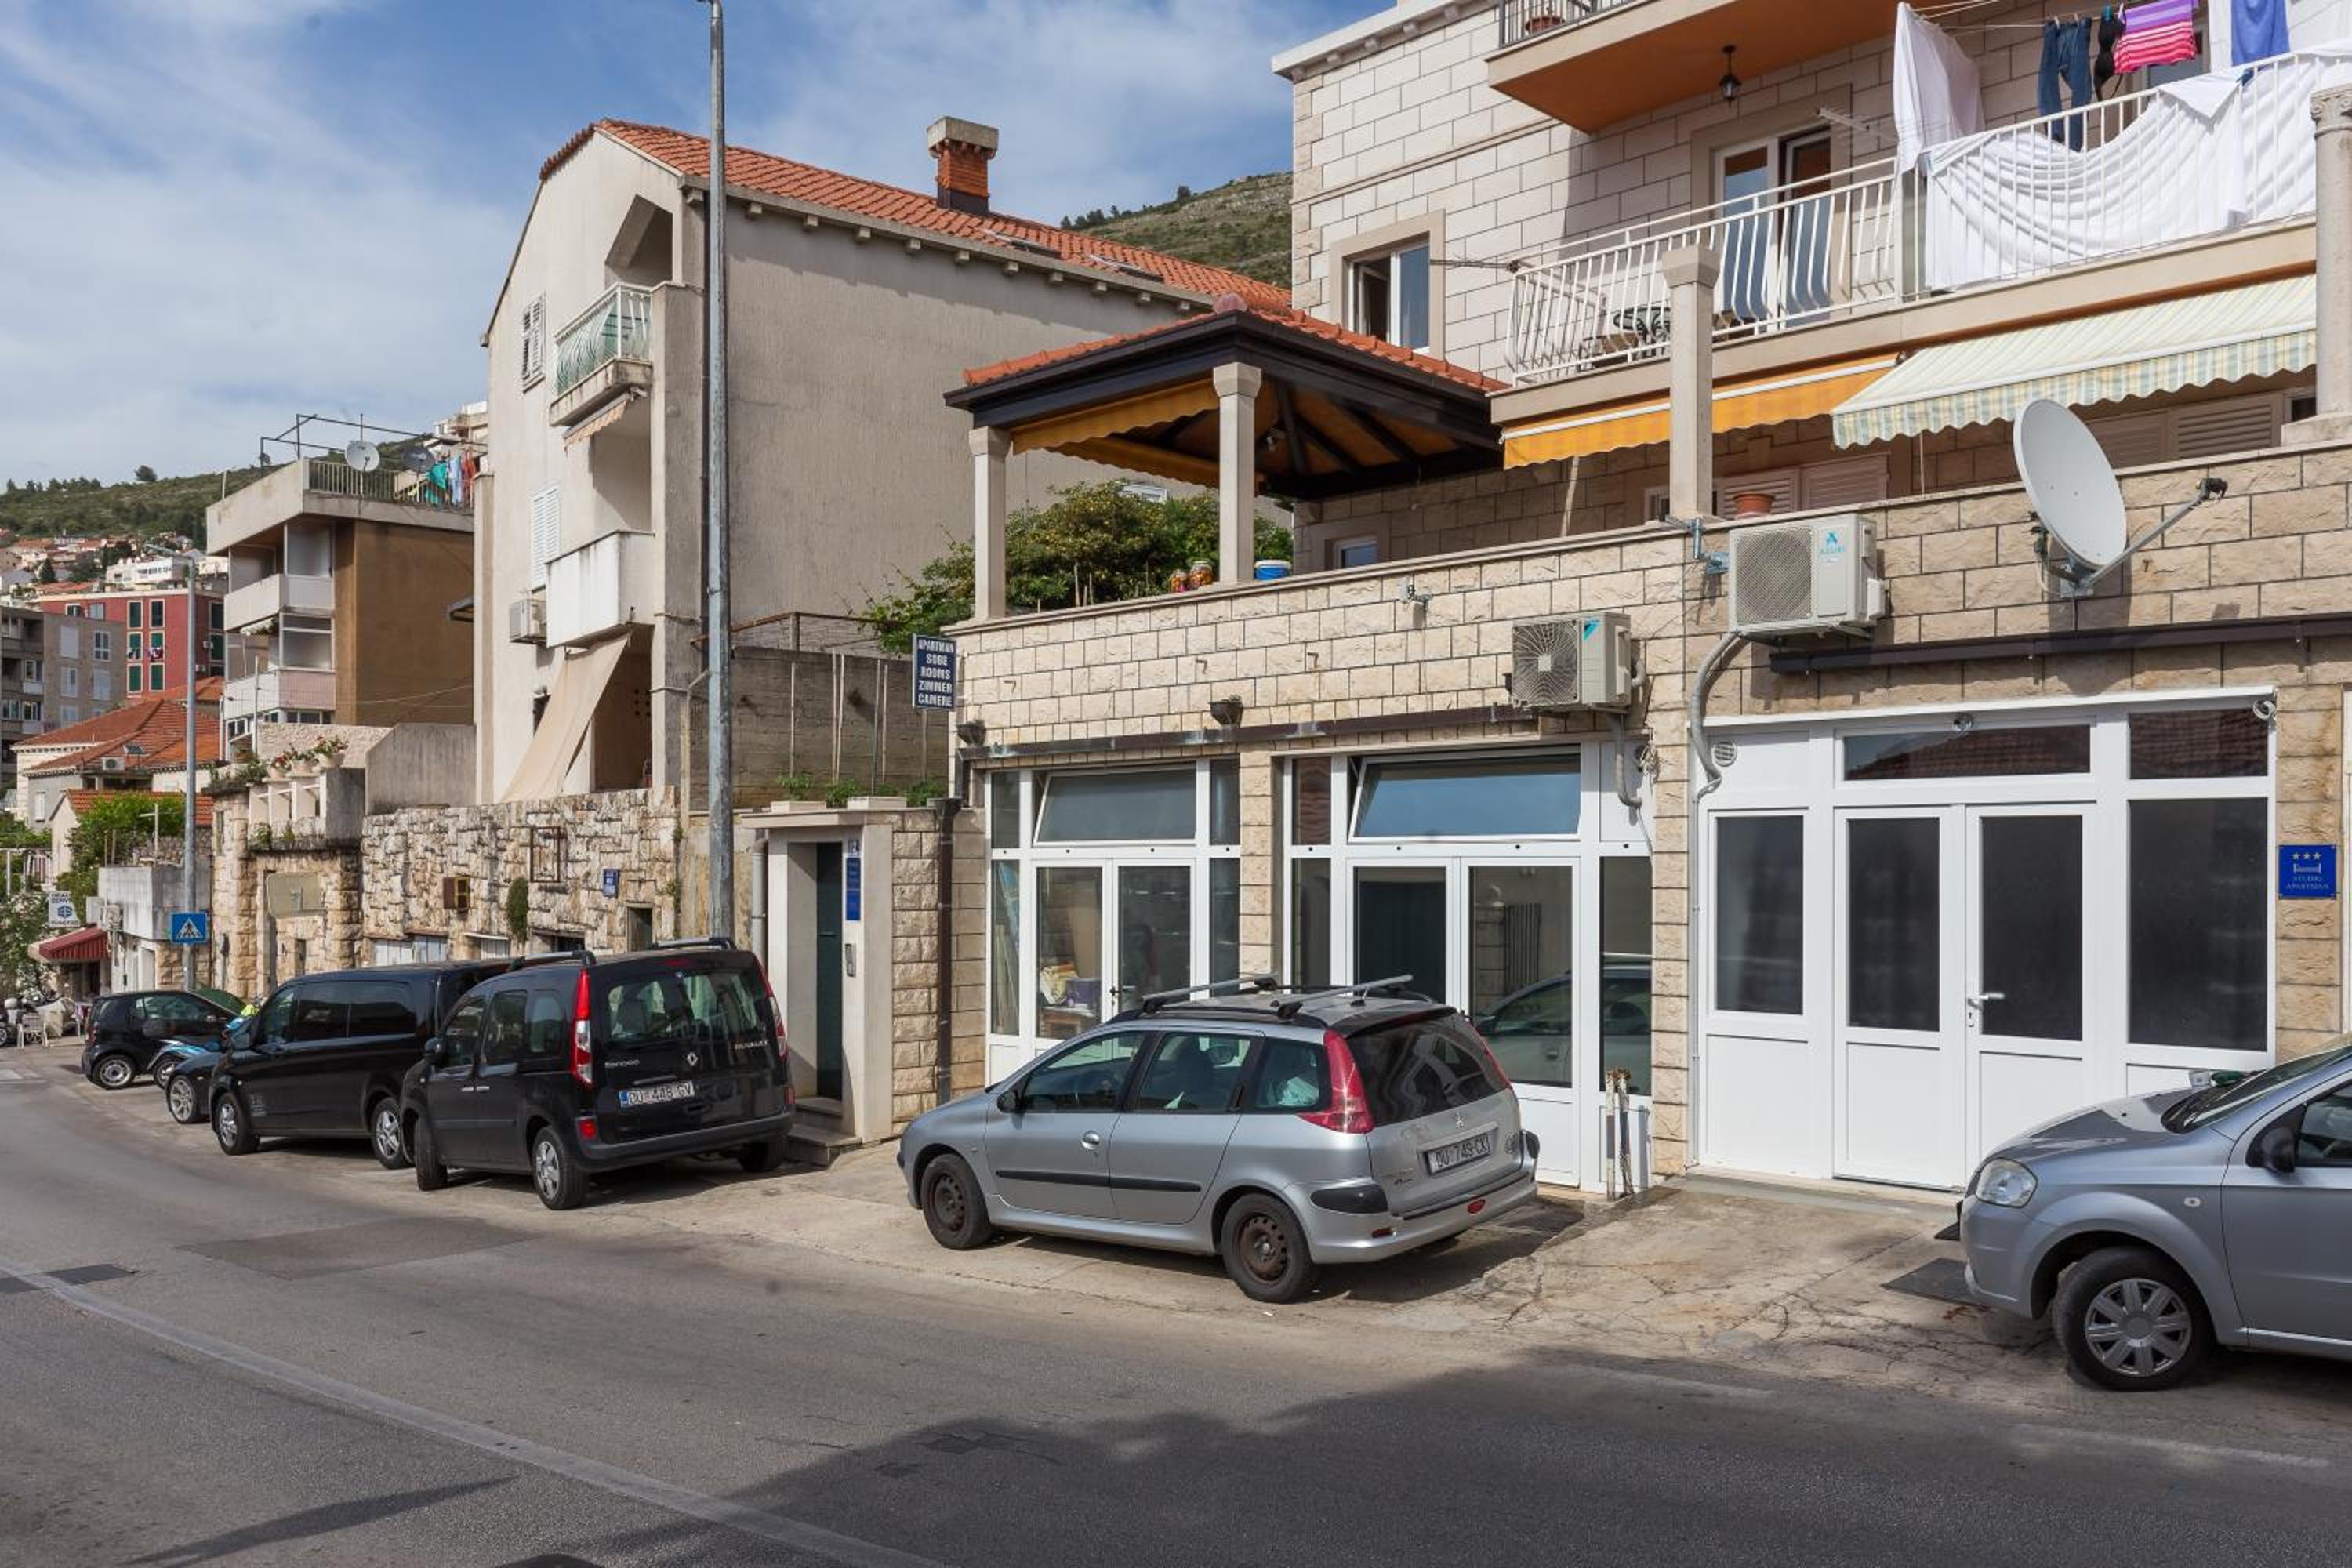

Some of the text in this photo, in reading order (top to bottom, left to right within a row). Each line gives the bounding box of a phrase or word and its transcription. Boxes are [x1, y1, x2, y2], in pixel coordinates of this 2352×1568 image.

[926, 652, 948, 666] SOBE
[920, 666, 951, 680] ROOMS
[918, 679, 953, 694] ZIMMER
[918, 692, 953, 707] CAMERE
[1436, 1149, 1450, 1167] DU
